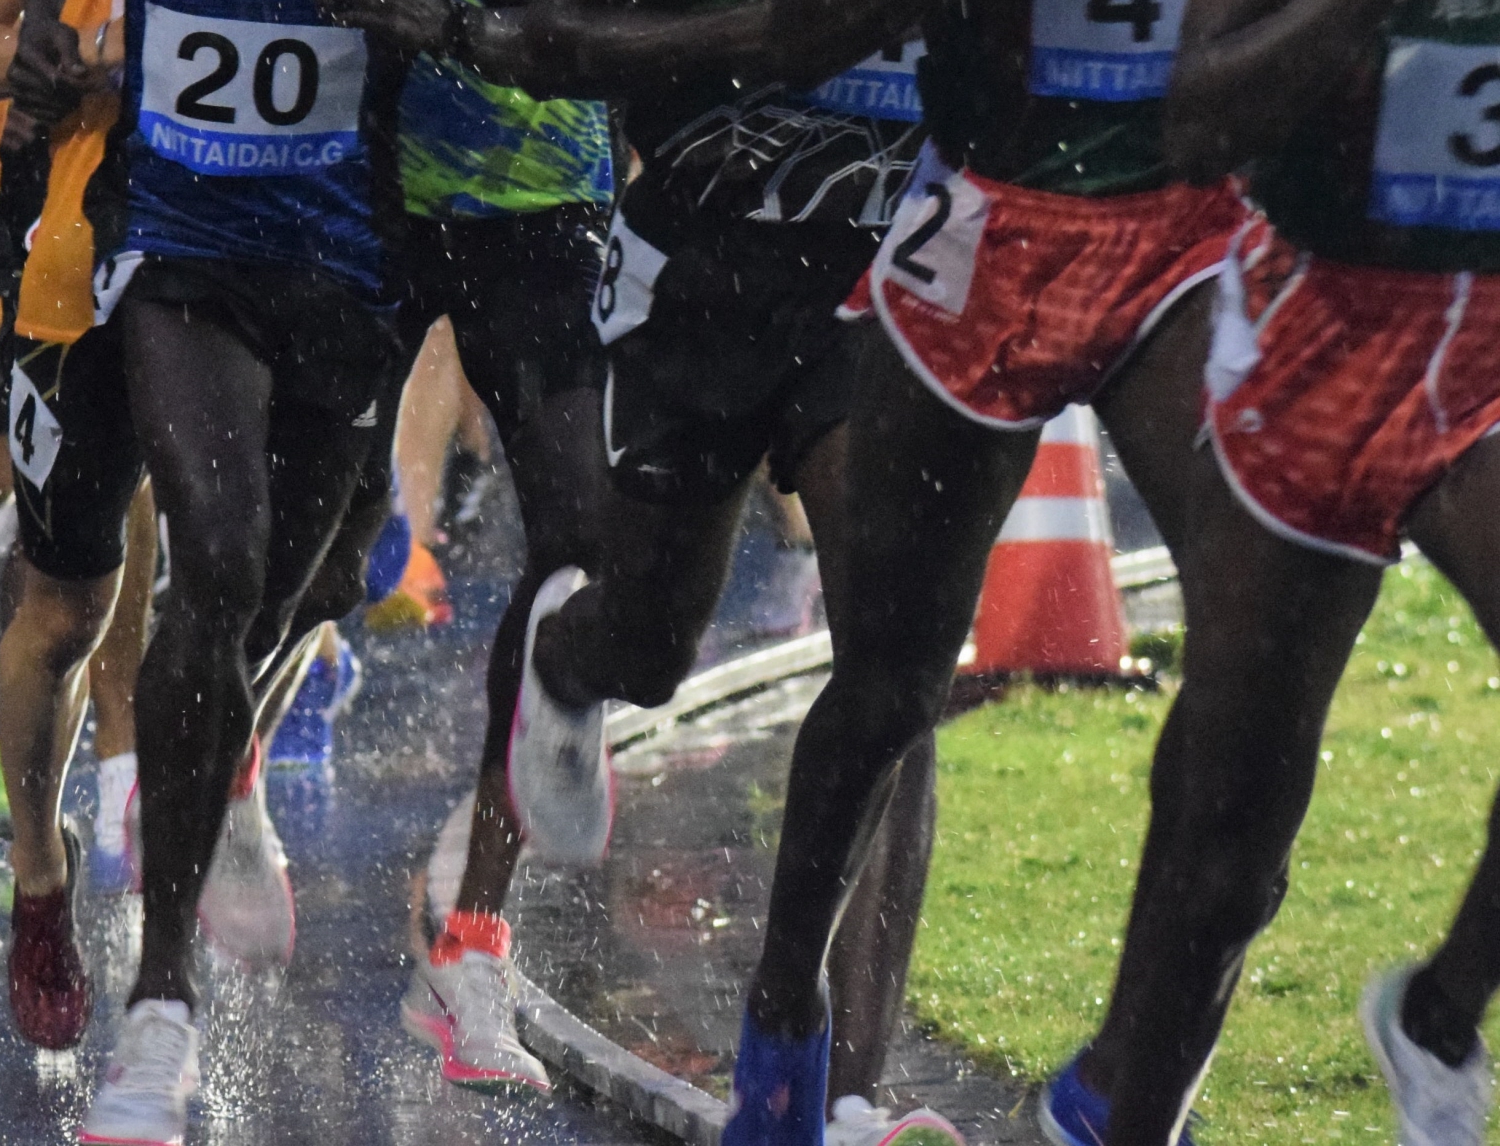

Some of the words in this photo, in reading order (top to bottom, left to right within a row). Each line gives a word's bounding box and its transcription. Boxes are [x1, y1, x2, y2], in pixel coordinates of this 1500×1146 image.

[175, 31, 320, 126] 20
[152, 122, 289, 167] NITTAIDAI
[891, 182, 952, 284] 2
[598, 236, 624, 322] 8
[15, 393, 36, 466] 4
